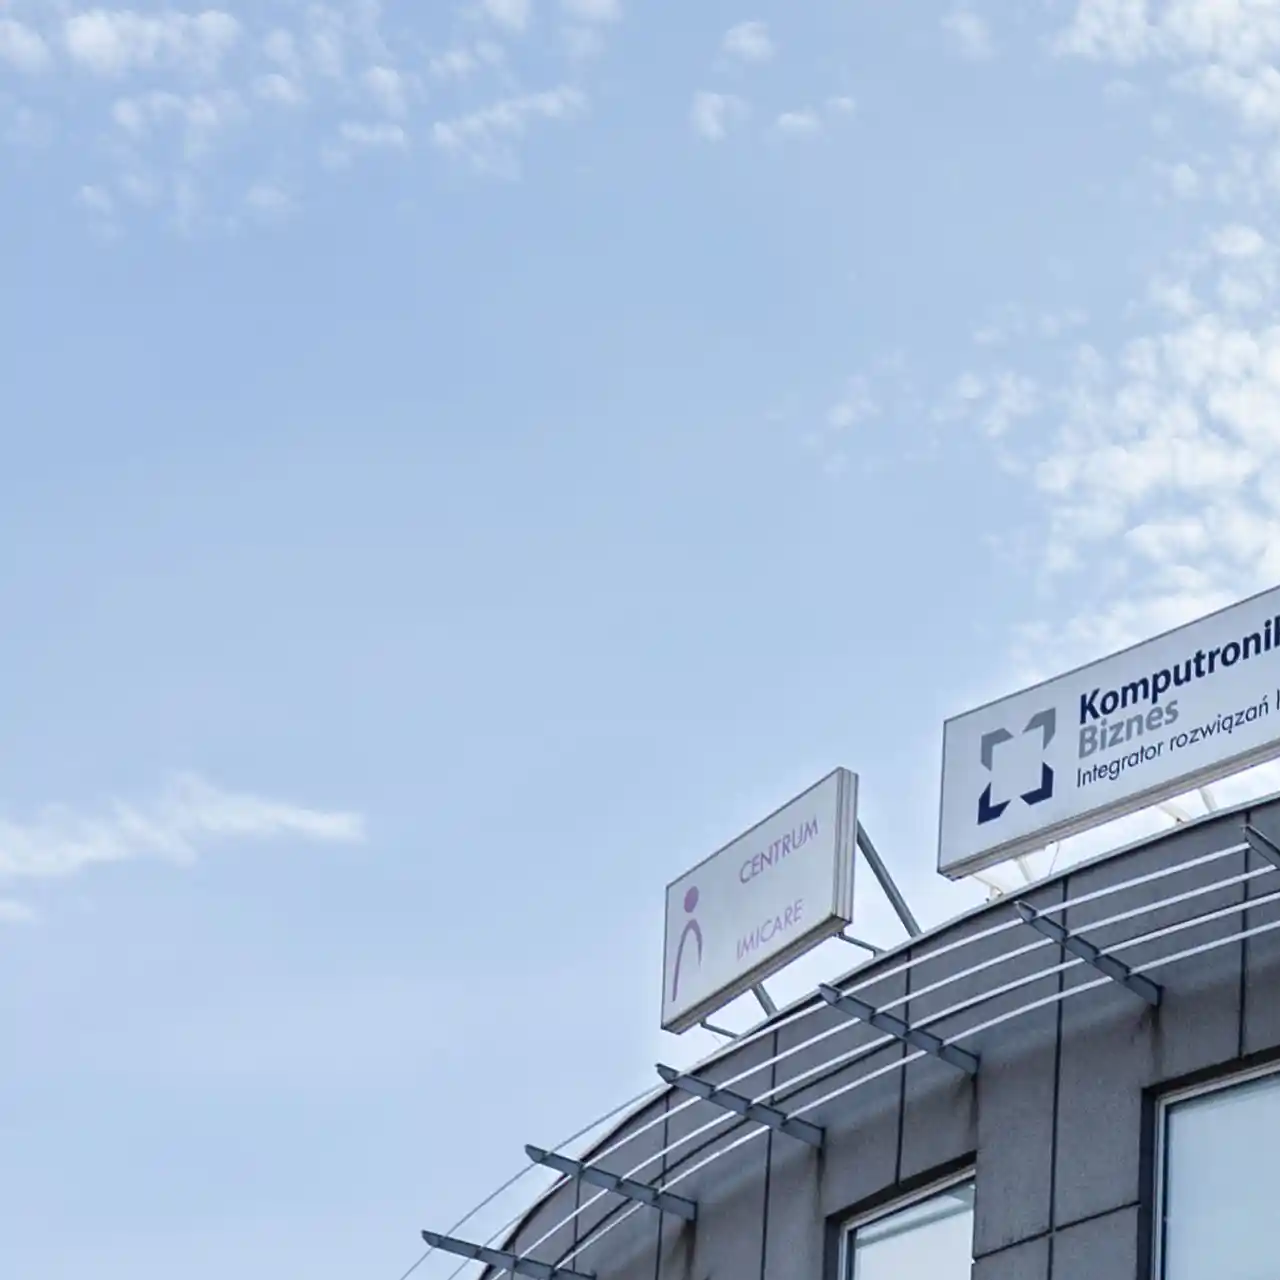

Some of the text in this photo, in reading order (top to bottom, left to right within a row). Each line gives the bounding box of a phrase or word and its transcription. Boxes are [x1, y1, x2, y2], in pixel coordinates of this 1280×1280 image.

[1077, 740, 1164, 788] Integrator
[1169, 697, 1270, 753] rozwiązań
[1078, 699, 1179, 759] Biznes
[739, 816, 819, 884] CENTRUM
[736, 899, 804, 961] IMICARE
